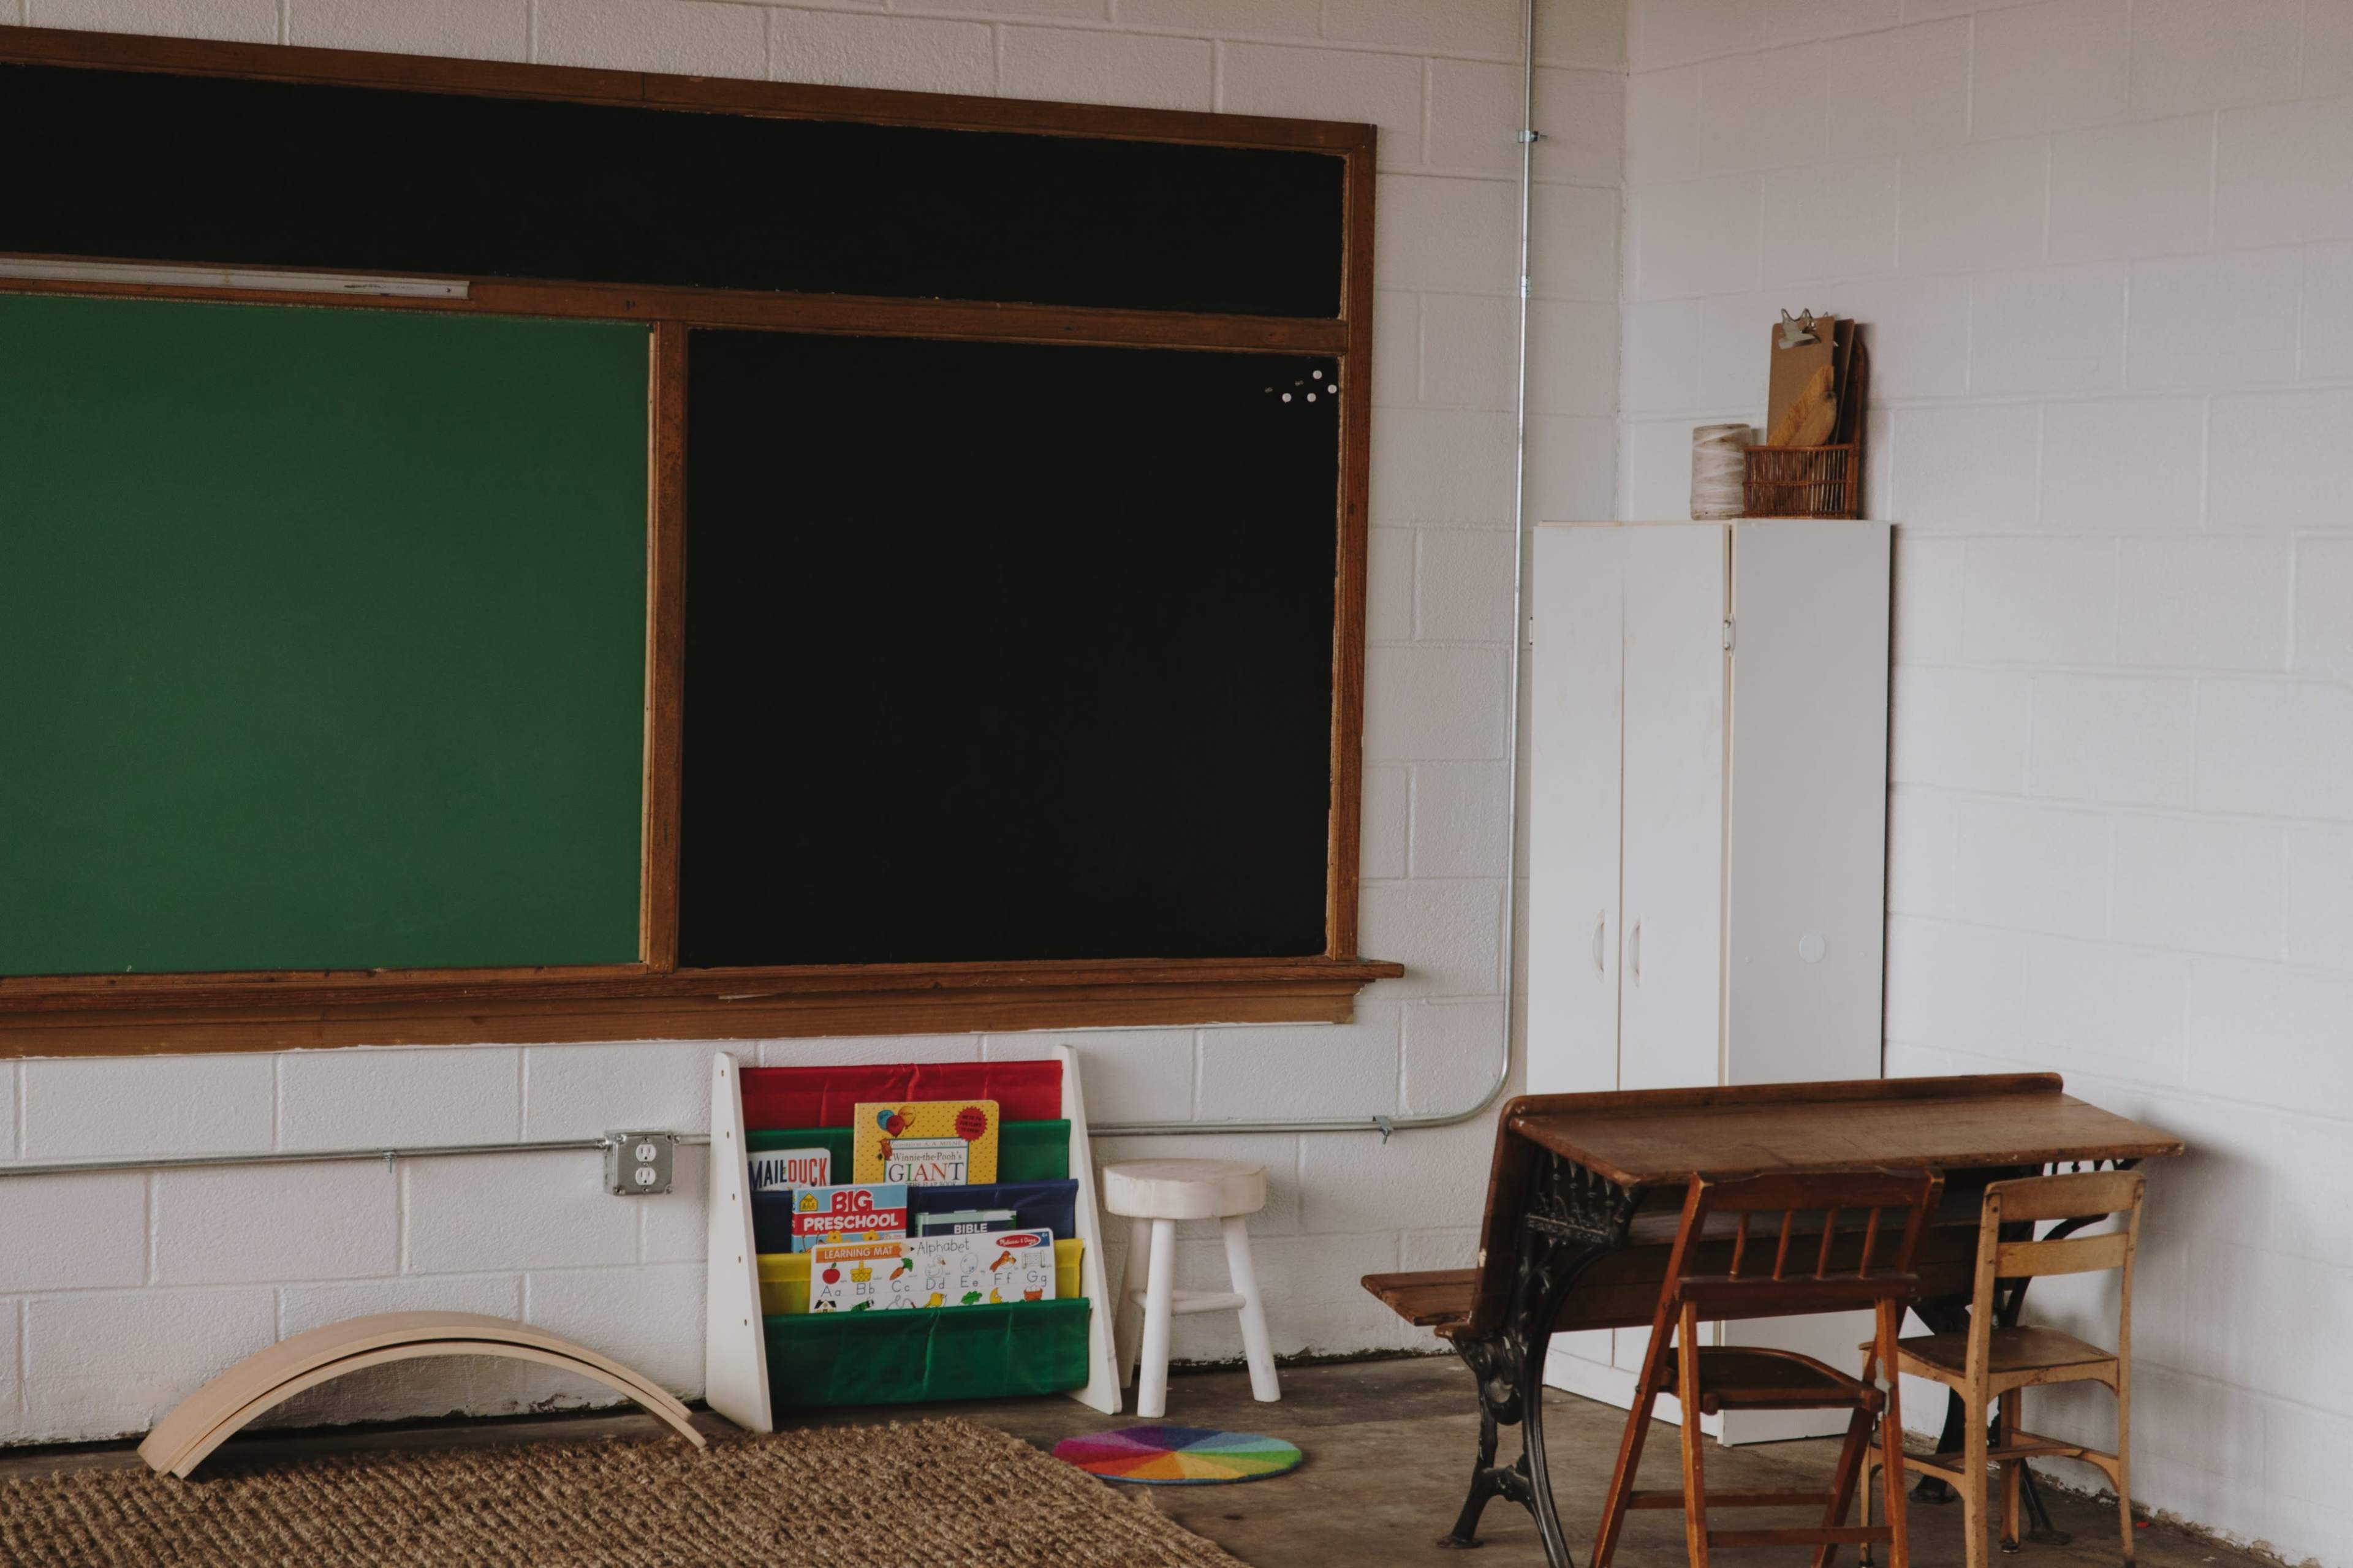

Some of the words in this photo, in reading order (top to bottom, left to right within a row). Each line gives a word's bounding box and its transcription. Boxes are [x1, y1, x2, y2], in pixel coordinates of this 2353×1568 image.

[748, 1159, 787, 1191] MAIL
[788, 1157, 827, 1186] DUCK
[889, 1162, 964, 1182] GIANT
[832, 1190, 873, 1211] BIG
[803, 1213, 898, 1231] PRESCHOOL
[953, 1223, 988, 1234] BIBLE
[824, 1248, 870, 1259] LEARNING
[874, 1246, 893, 1256] MAT
[917, 1238, 970, 1256] Alphabet
